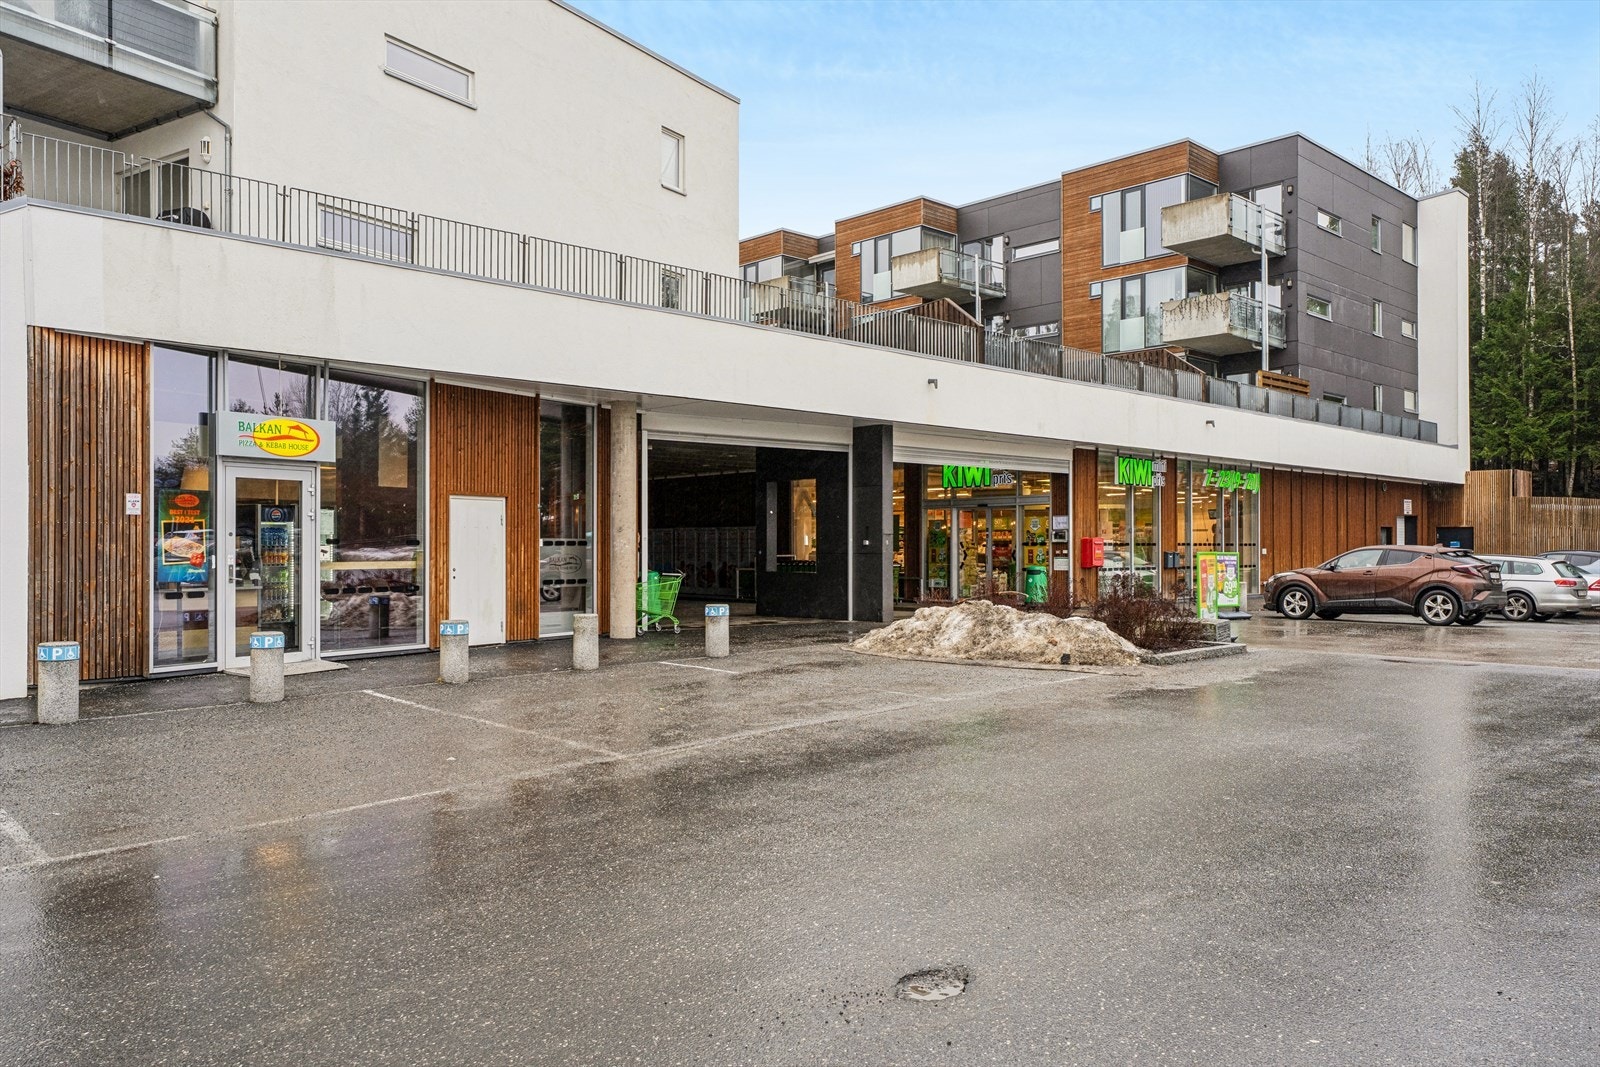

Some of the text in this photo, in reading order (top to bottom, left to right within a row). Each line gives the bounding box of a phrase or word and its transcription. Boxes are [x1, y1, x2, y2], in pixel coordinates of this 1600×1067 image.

[238, 421, 282, 435] BALKAN
[239, 440, 257, 448] PIZZA
[266, 442, 287, 450] KEBAB
[288, 443, 309, 451] HOUSE
[943, 466, 991, 488] KIWI
[1117, 456, 1152, 487] KIWI
[993, 471, 1013, 487] pris
[175, 516, 195, 524] 2024
[719, 607, 725, 616] P
[457, 624, 464, 634] P
[265, 636, 273, 648] P
[52, 647, 63, 660] P
